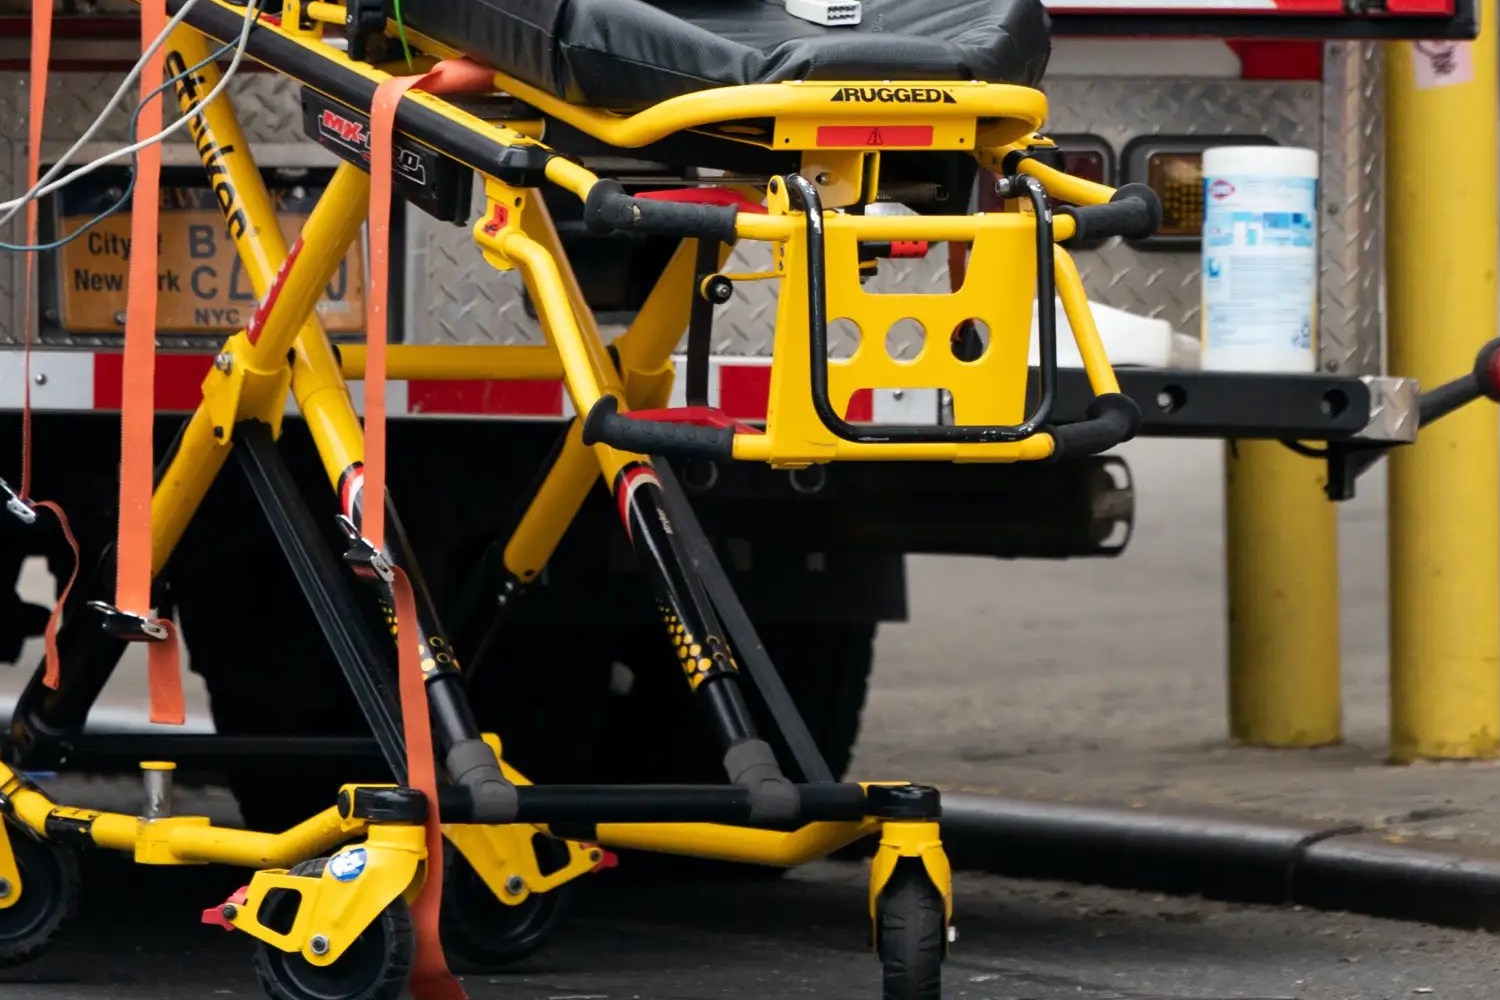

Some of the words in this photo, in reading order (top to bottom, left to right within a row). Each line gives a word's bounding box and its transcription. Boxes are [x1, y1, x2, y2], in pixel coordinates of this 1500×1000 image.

[843, 88, 941, 103] RUGGED
[88, 231, 131, 261] City
[74, 267, 122, 291] New
[195, 308, 241, 325] NYC
